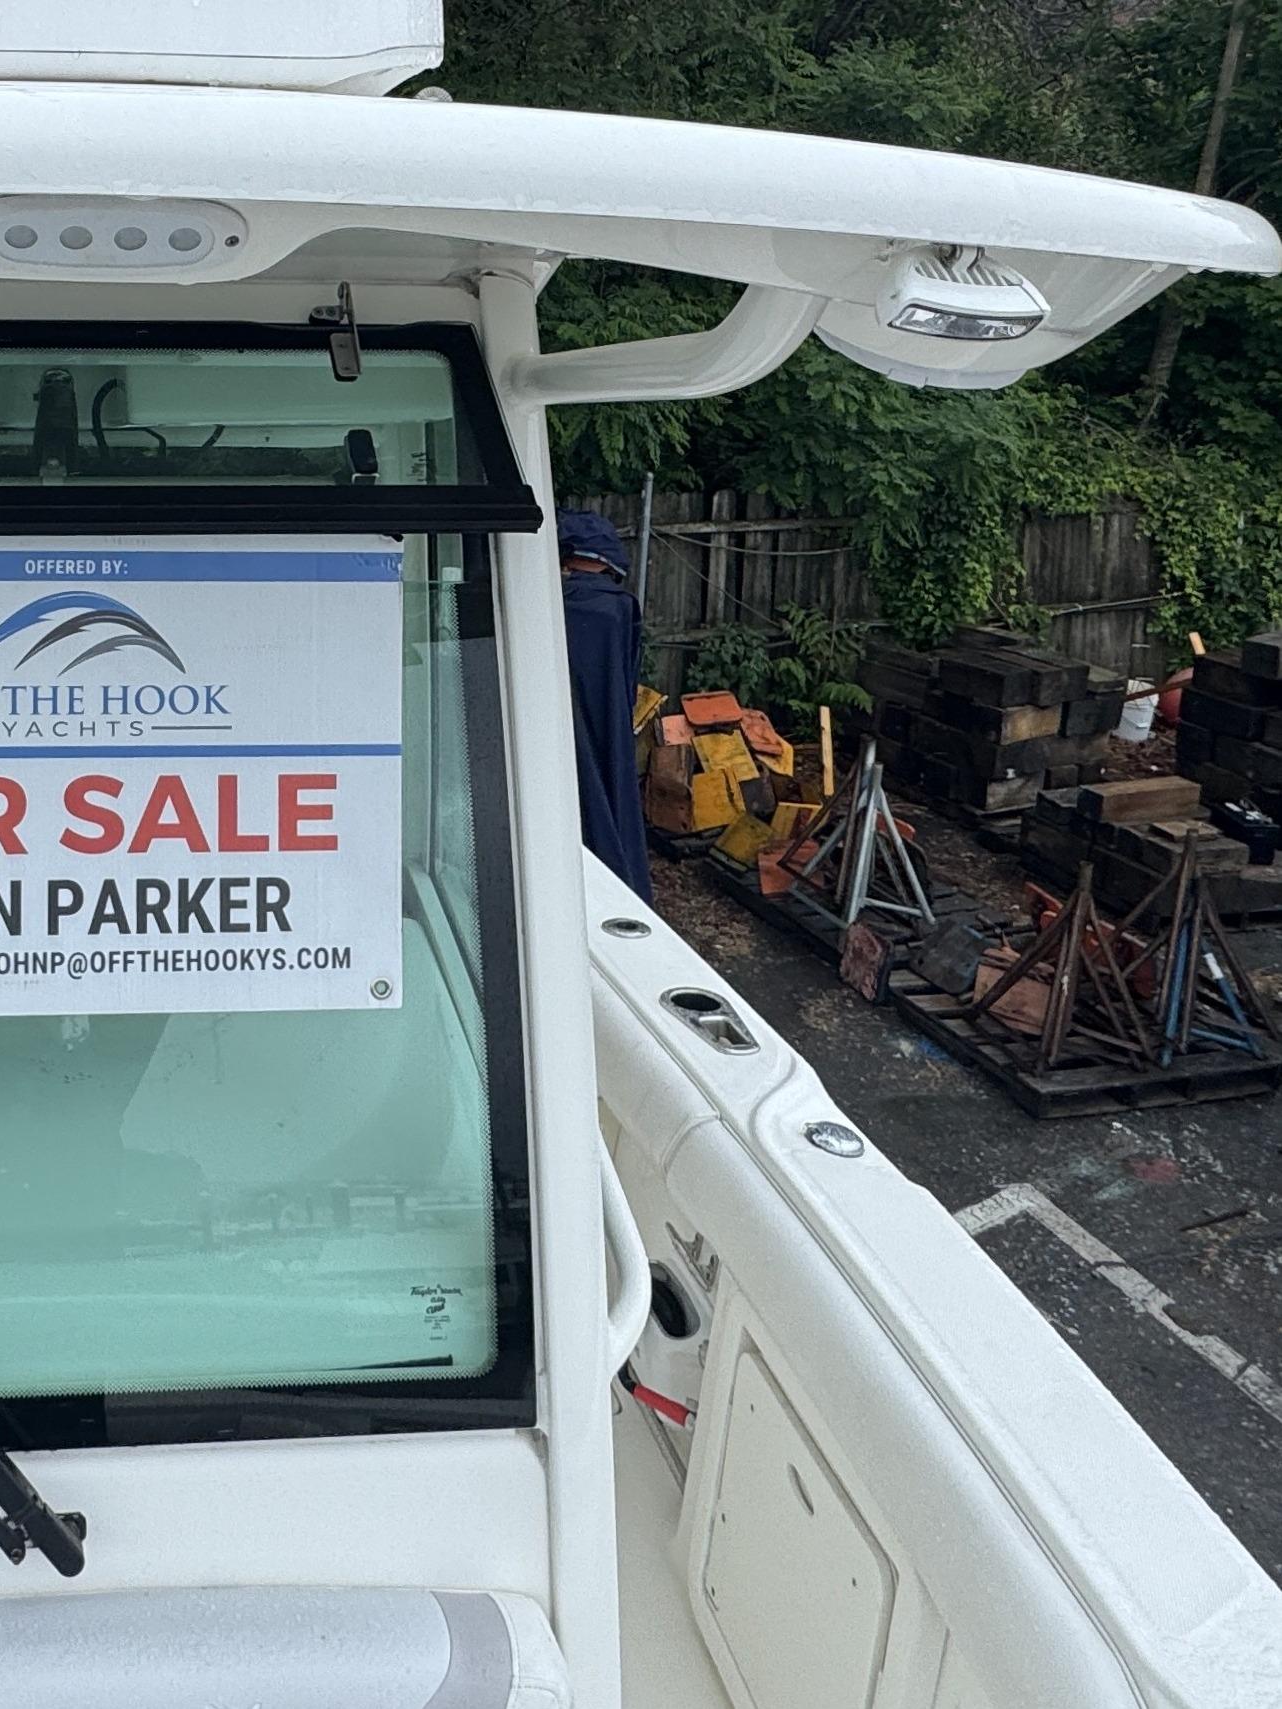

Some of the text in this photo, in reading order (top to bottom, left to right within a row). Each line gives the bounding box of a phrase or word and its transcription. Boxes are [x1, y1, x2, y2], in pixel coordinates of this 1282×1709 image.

[24, 559, 128, 575] OFFERED BY:
[1, 685, 85, 716] THE
[101, 684, 230, 716] HOOK
[1, 720, 144, 738] YACHTS
[58, 773, 340, 855] SALE
[47, 876, 293, 936] PARKER
